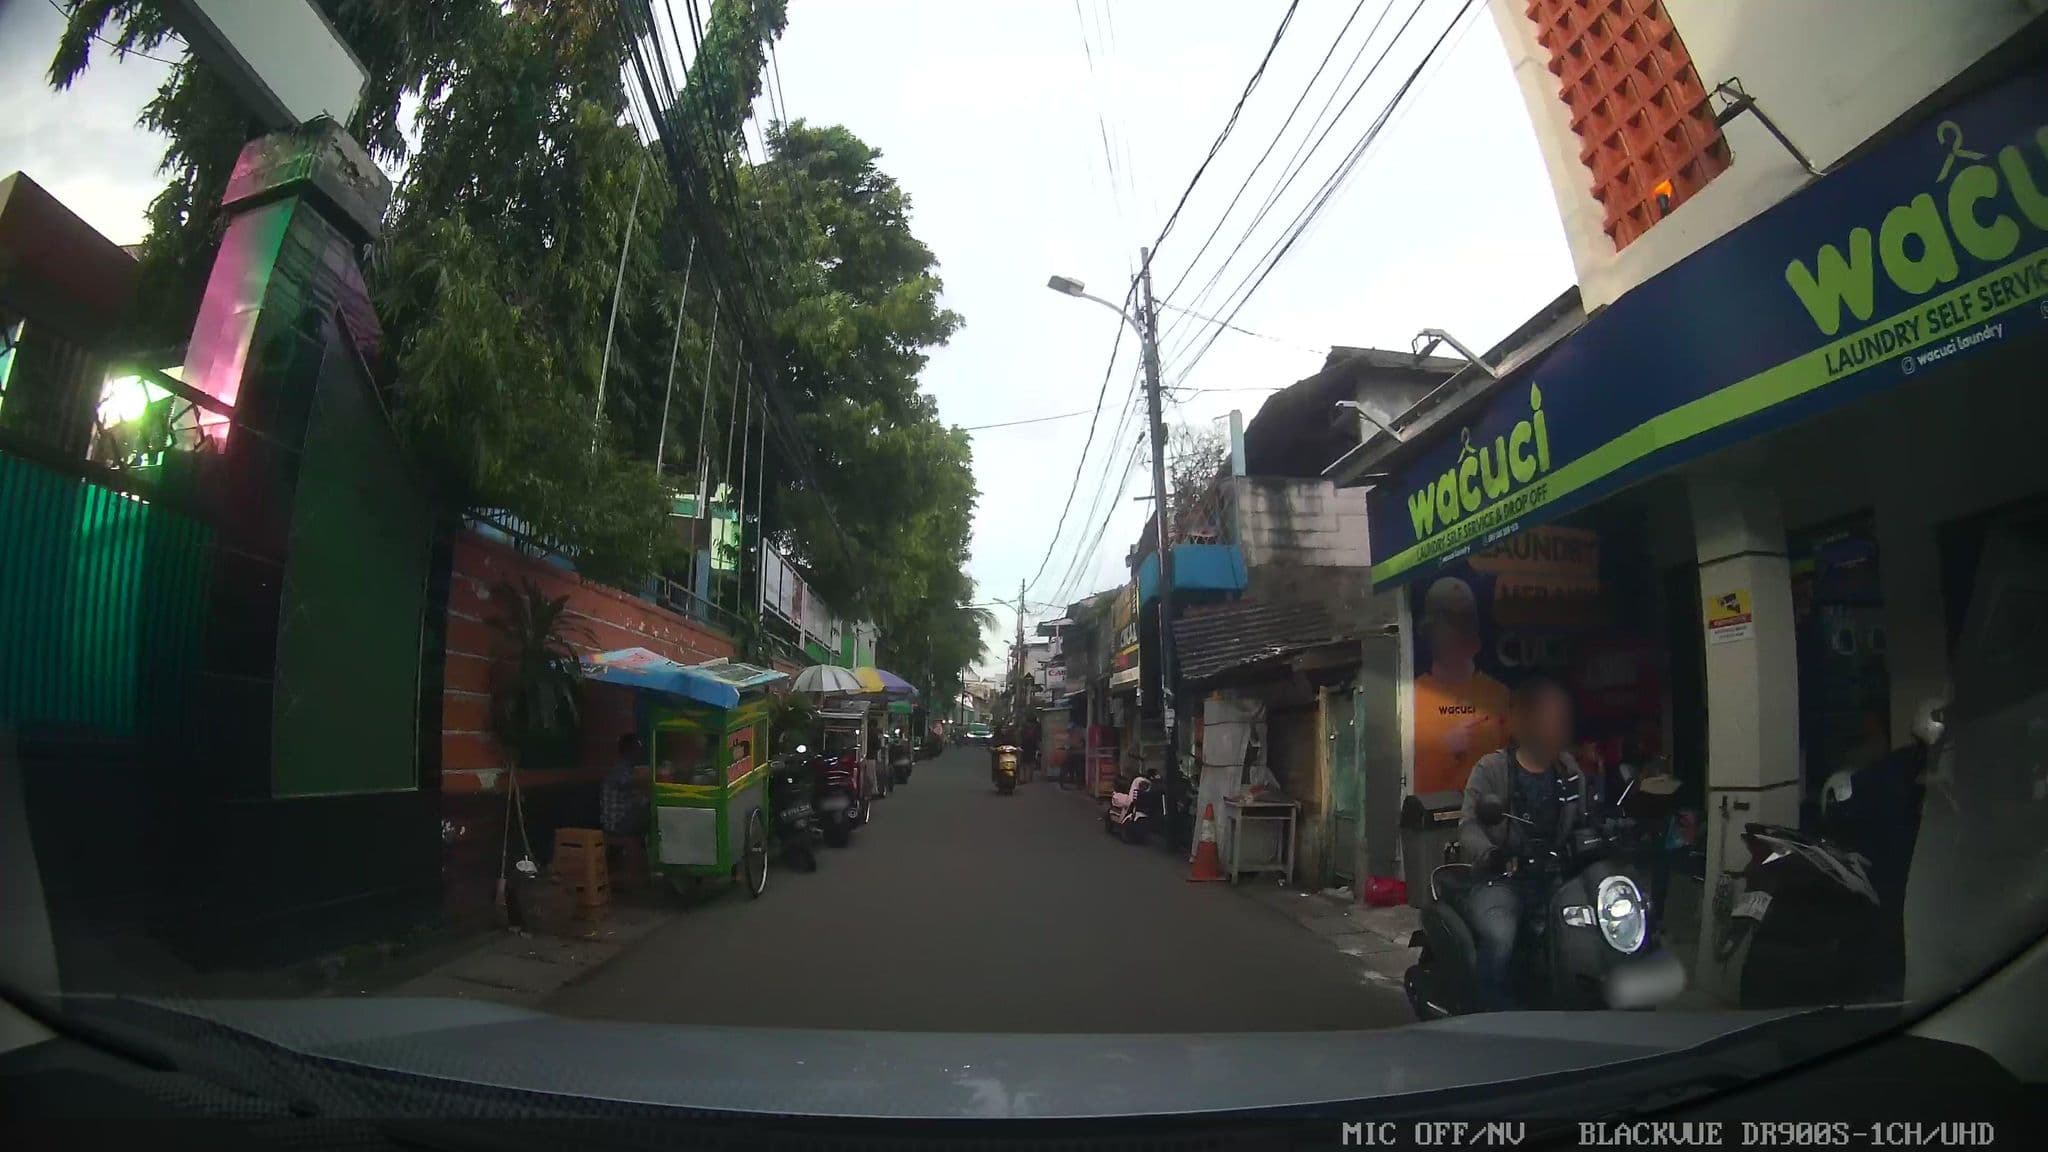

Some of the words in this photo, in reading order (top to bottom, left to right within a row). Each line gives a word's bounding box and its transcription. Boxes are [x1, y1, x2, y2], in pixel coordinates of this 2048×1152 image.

[1825, 313, 1921, 376] LAUNDRY
[1926, 292, 1972, 334] SELF
[1916, 338, 1958, 367] wacuci
[1957, 323, 2003, 350] laundry
[1407, 382, 1551, 541] wacuci
[1416, 534, 1446, 561] LAUNDRY
[1463, 510, 1494, 538] SERVICE
[1503, 494, 1527, 520] DROP
[1528, 483, 1548, 506] OFF
[1438, 704, 1476, 715] wacuci
